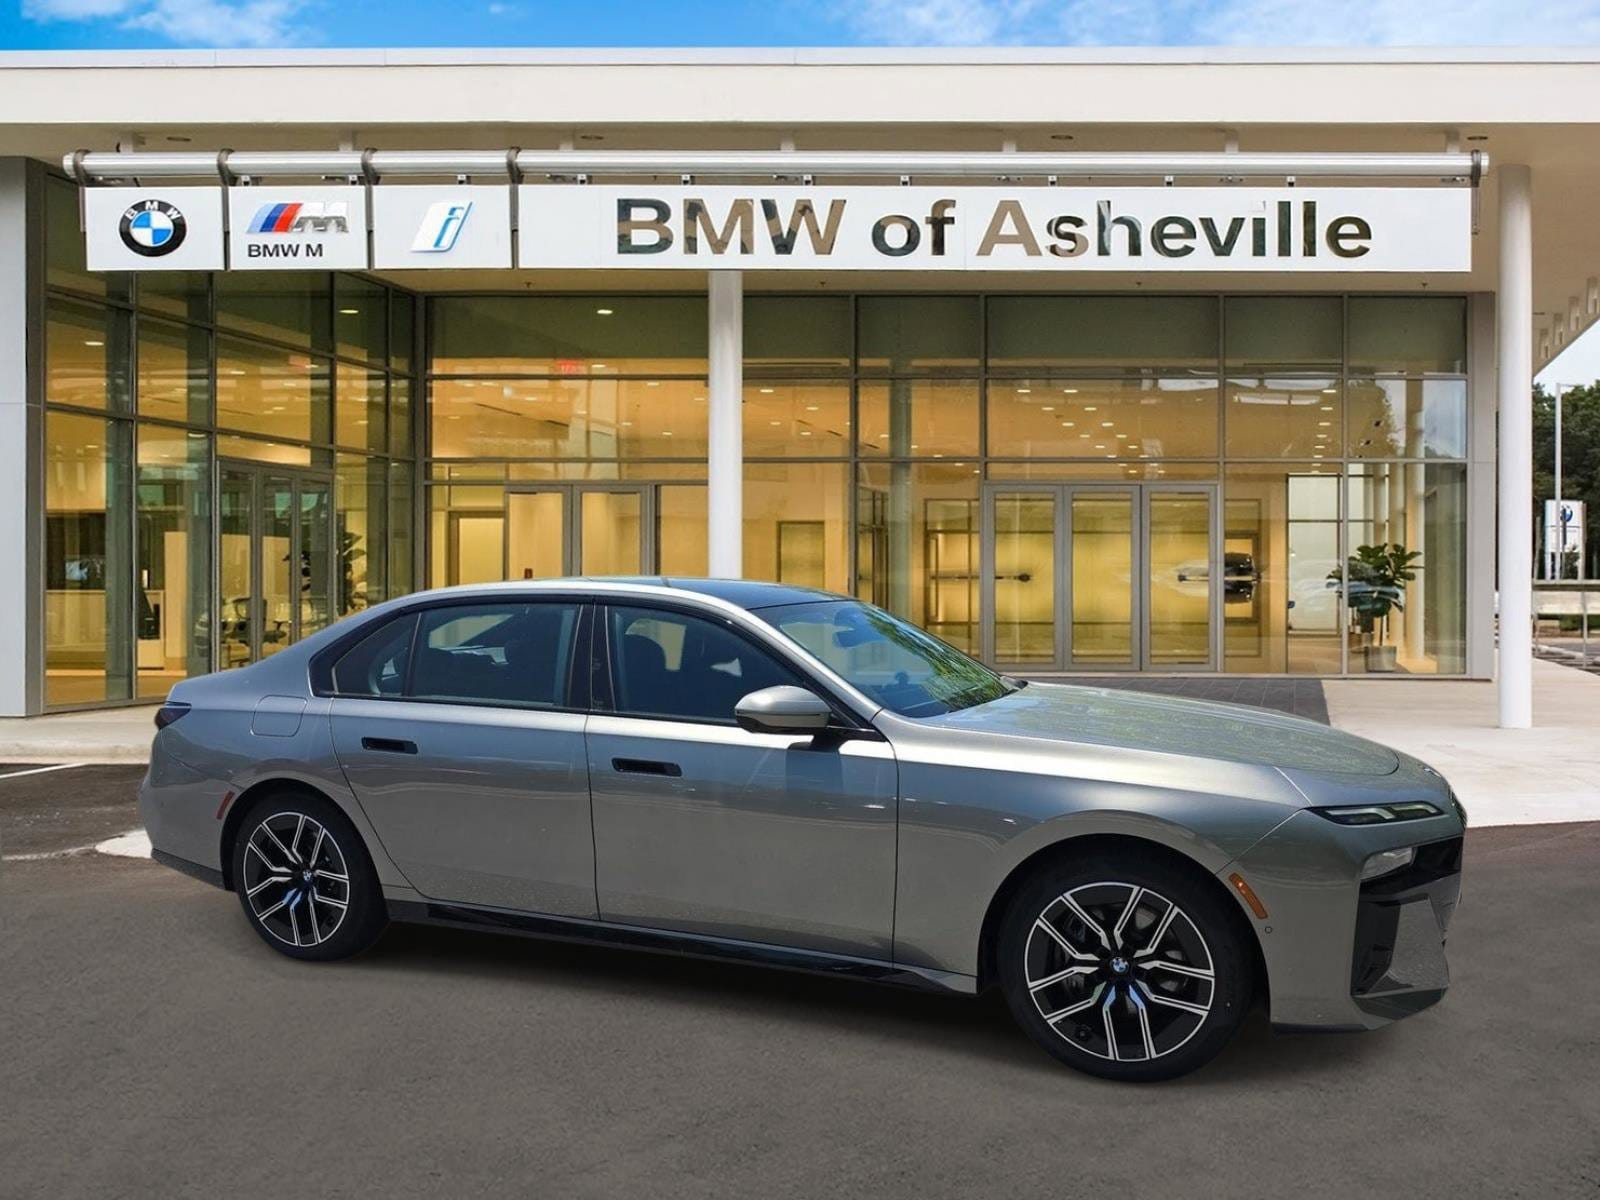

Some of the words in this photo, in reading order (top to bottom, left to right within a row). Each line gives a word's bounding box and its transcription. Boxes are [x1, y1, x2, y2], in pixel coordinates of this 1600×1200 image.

[124, 201, 181, 219] BMW
[617, 198, 847, 255] BMW
[871, 199, 956, 256] of
[976, 199, 1372, 258] Asheville
[248, 244, 299, 257] BMW
[306, 244, 323, 257] M
